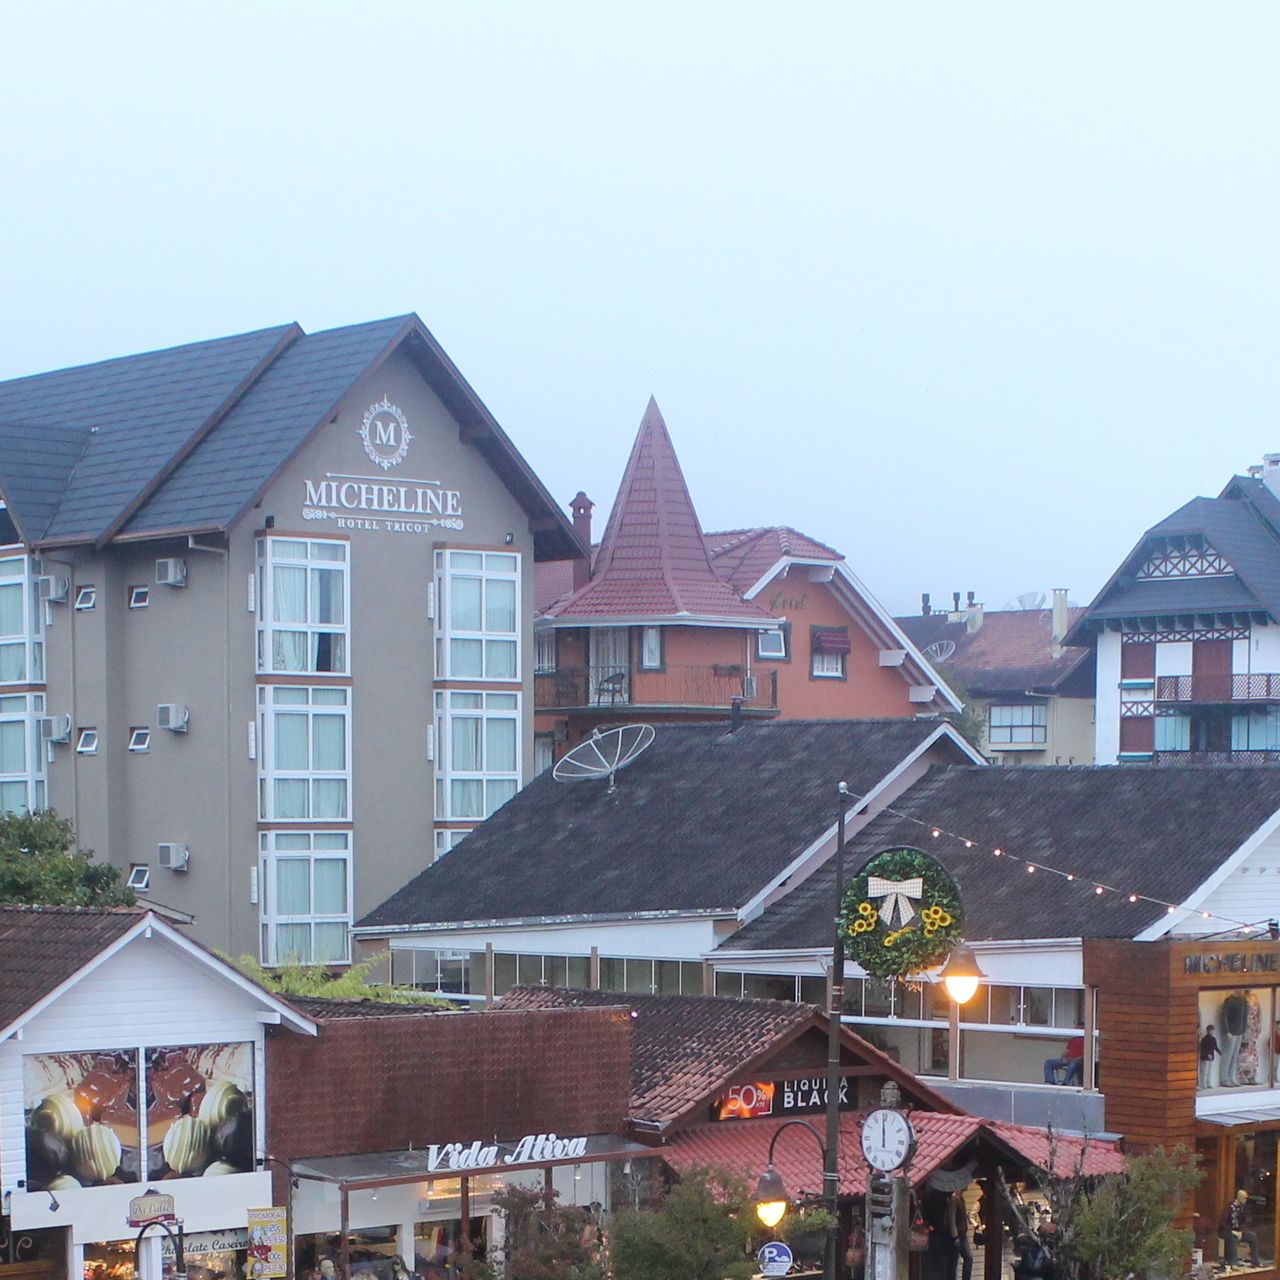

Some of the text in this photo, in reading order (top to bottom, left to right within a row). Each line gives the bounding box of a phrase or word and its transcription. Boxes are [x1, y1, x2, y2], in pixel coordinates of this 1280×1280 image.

[374, 420, 398, 446] M
[303, 480, 462, 516] MICHELINE
[337, 518, 431, 533] HOTEL TRICOT
[784, 1076, 848, 1091] LIQUIA
[426, 1133, 588, 1173] Vida Ativa
